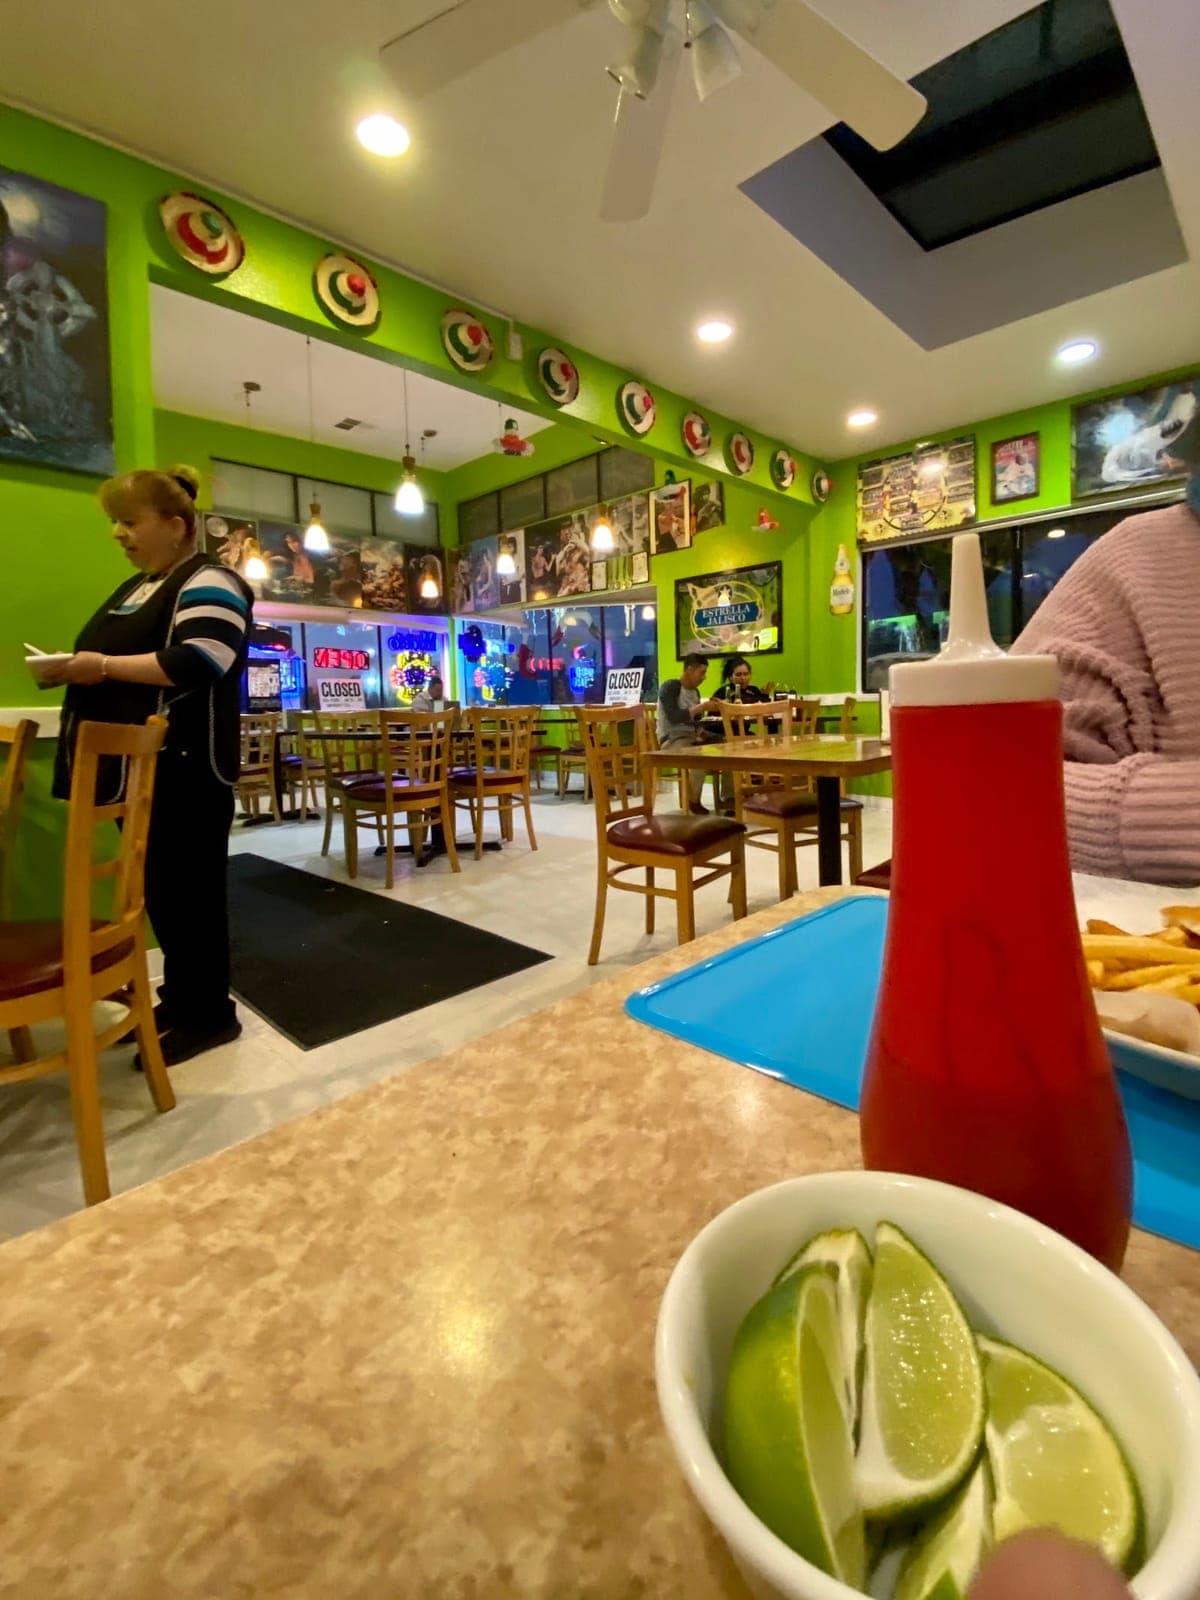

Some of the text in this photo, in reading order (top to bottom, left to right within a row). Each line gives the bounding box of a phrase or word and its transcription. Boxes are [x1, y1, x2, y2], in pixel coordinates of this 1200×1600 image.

[702, 604, 751, 618] ESTRELLA
[707, 613, 746, 626] JALISCO
[608, 672, 641, 690] CLOSED
[321, 681, 361, 698] CLOSED
